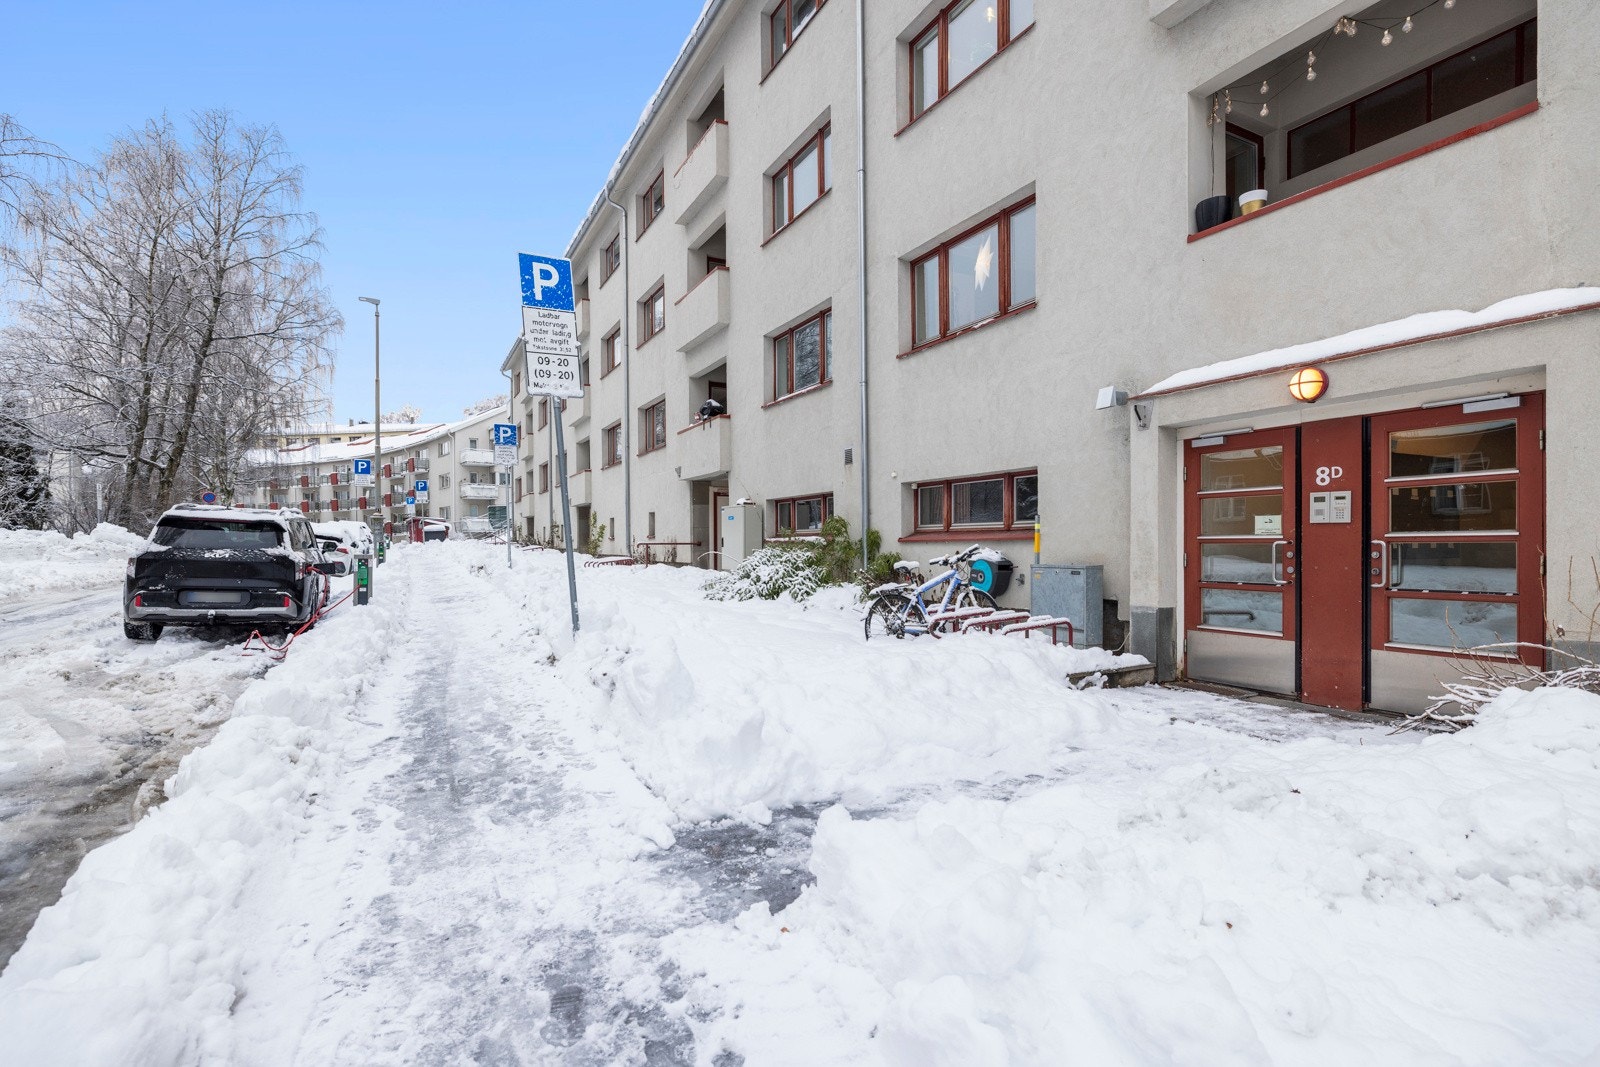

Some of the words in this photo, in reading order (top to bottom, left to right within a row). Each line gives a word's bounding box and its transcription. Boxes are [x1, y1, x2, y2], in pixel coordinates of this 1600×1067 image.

[532, 261, 560, 301] P
[538, 311, 561, 320] Ladbar
[550, 338, 570, 346] avgift
[537, 356, 569, 367] 09-20
[534, 369, 574, 381] (09-20)
[500, 426, 512, 443] P
[358, 461, 367, 473] P
[1315, 466, 1343, 486] 8D
[418, 481, 425, 491] P
